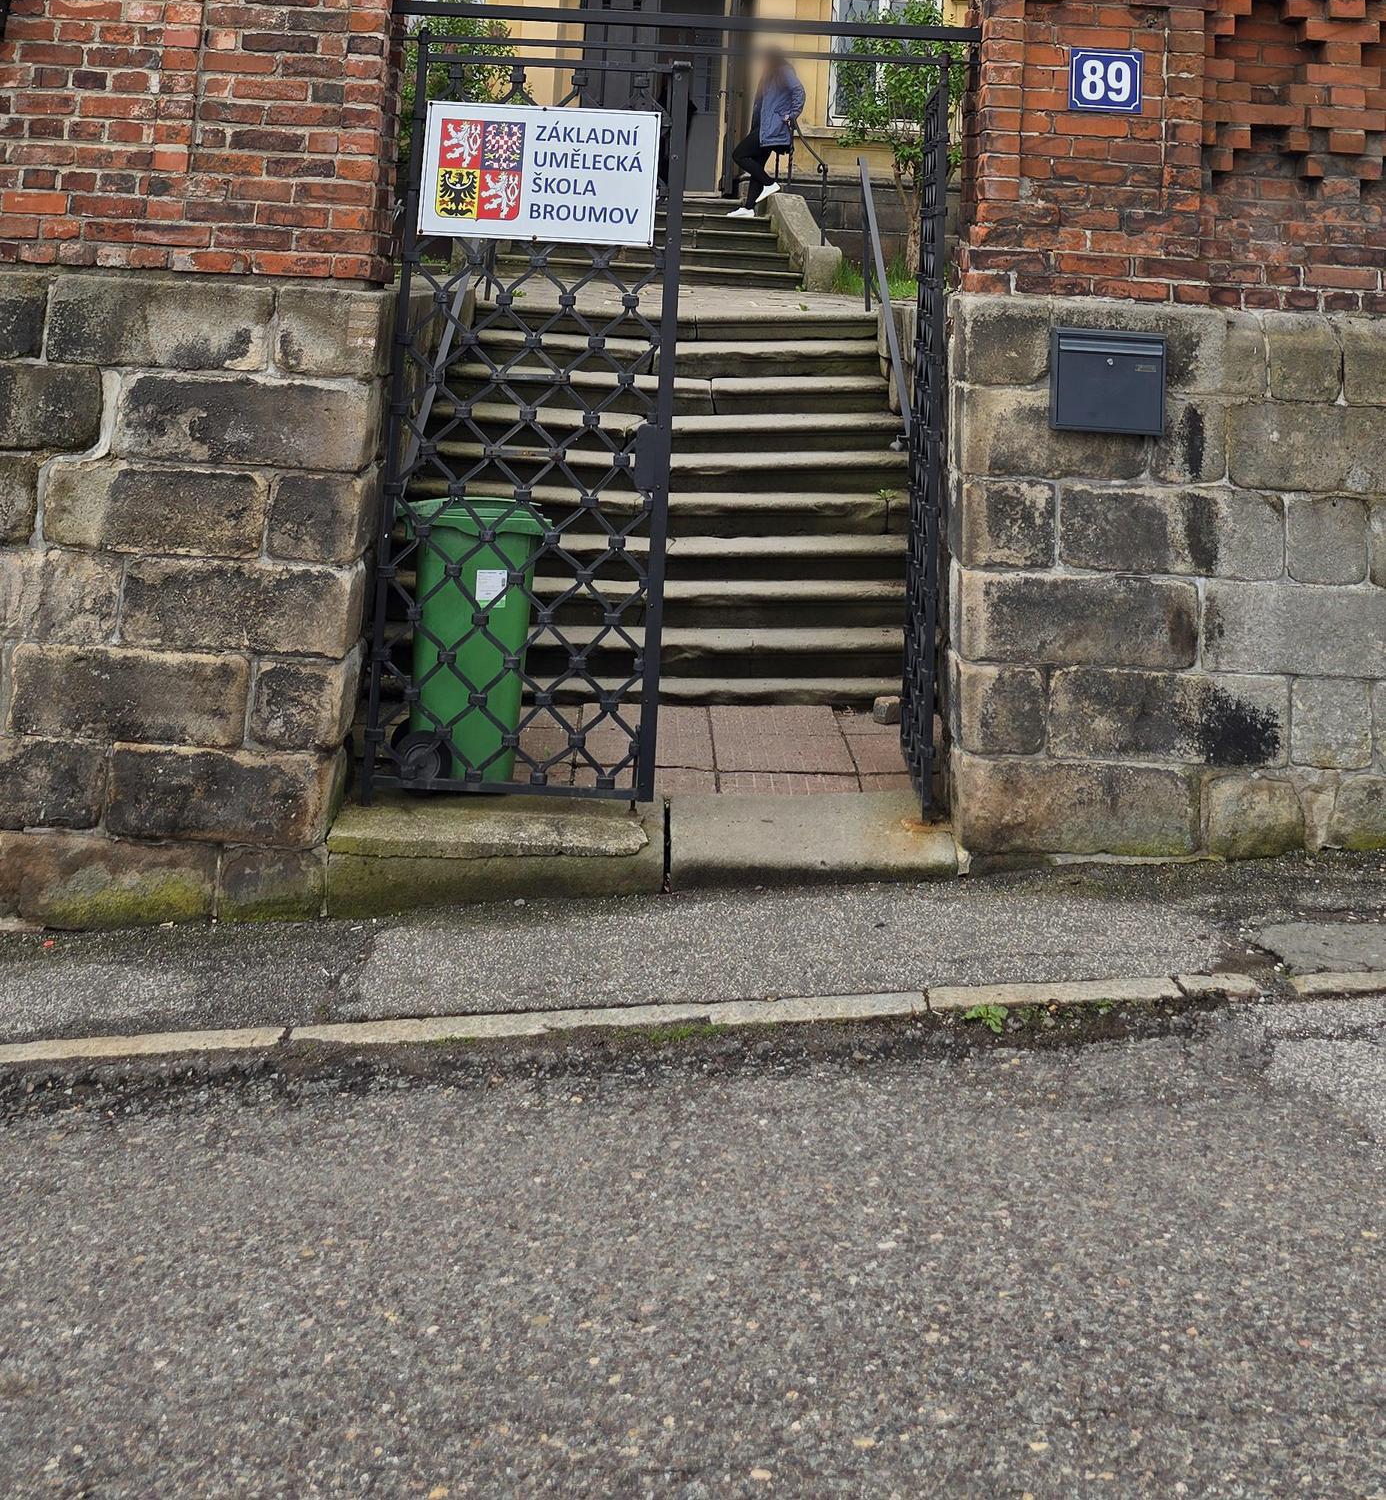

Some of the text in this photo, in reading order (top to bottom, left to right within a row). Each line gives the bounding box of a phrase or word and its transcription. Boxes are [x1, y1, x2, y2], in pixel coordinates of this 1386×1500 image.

[1081, 59, 1131, 102] 89
[535, 120, 640, 147] ZÁKLADNÍ
[533, 148, 643, 173] UMĚLECKÁ
[531, 171, 597, 197] ŠKOLA
[529, 202, 639, 225] BROUMOV
